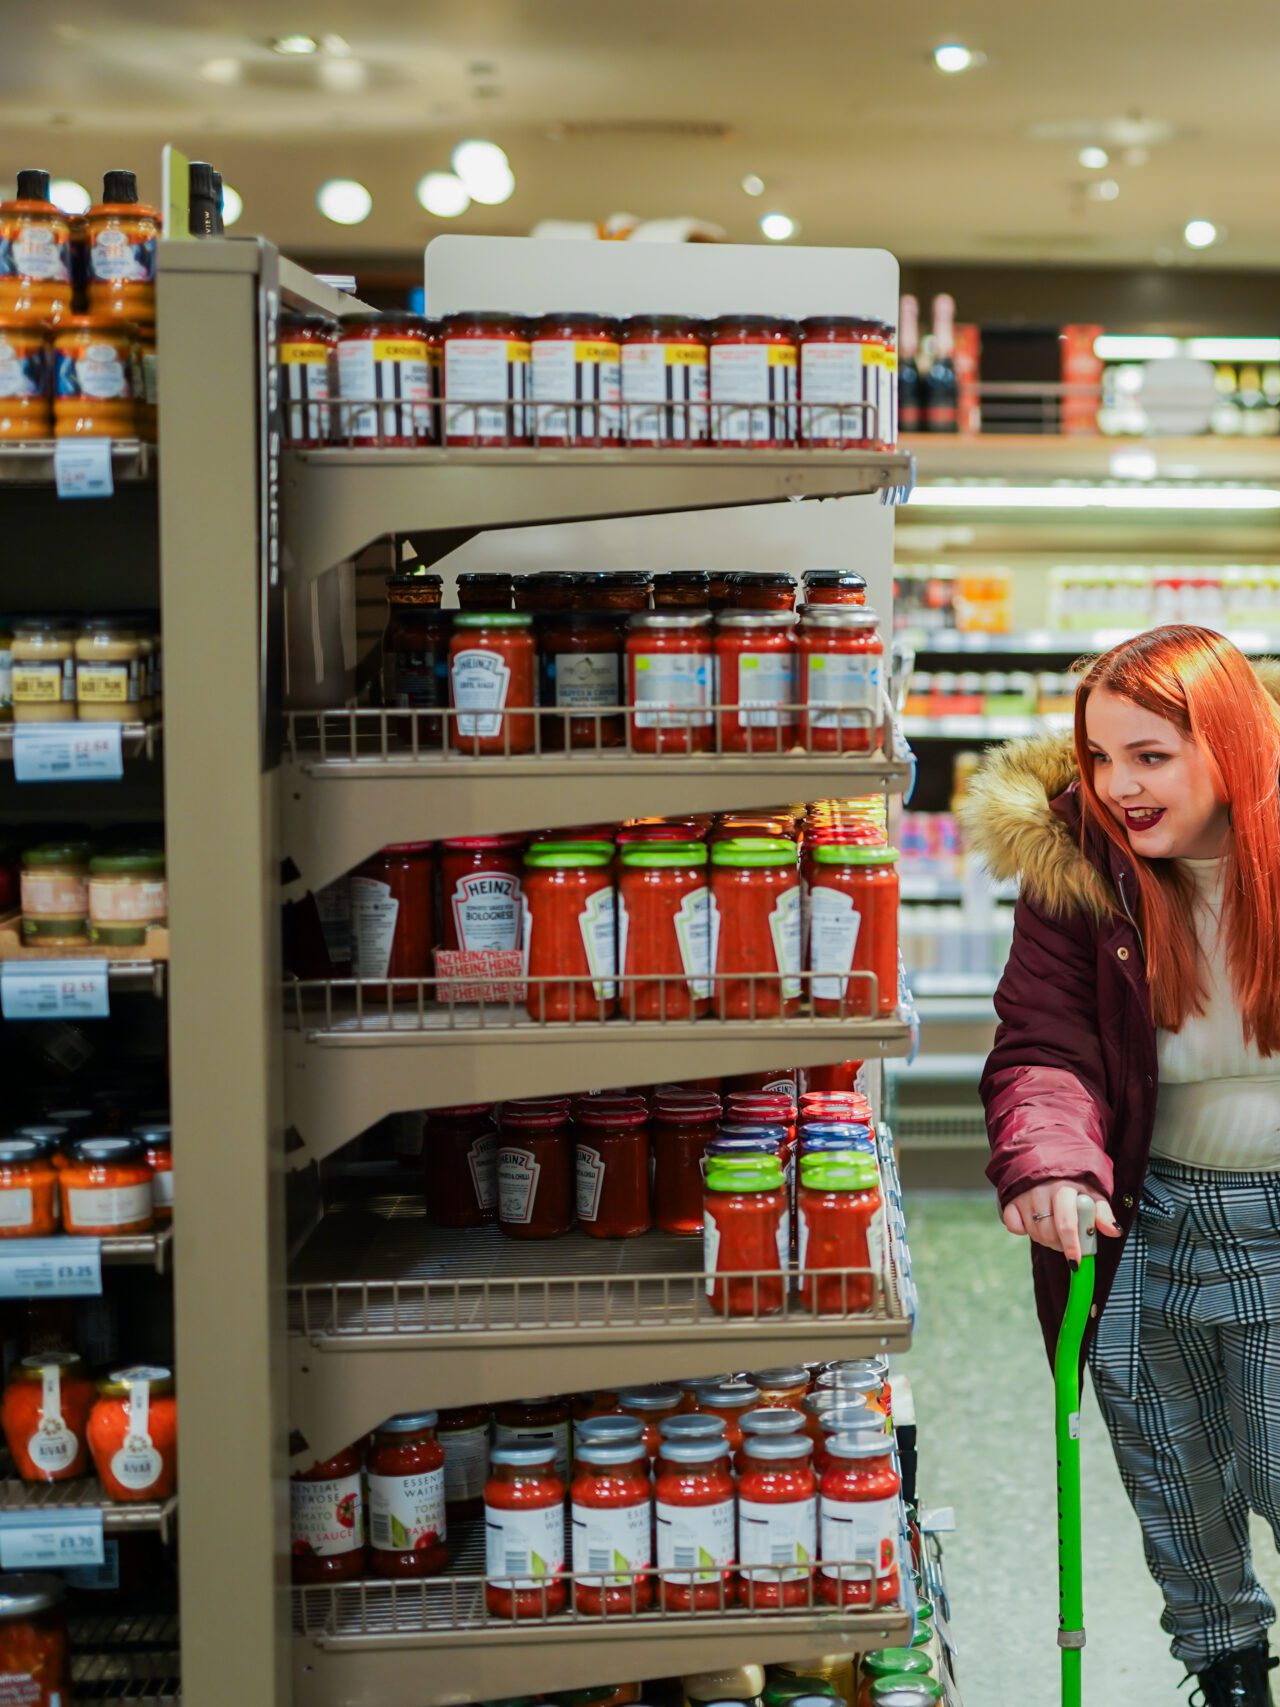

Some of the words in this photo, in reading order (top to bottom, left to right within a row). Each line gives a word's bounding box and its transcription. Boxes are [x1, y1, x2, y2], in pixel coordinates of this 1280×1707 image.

[468, 881, 512, 895] HEINZ
[466, 911, 514, 920] BOLOGNESE
[455, 960, 487, 974] HEINZ
[489, 956, 520, 970] HEINZ
[316, 1530, 353, 1542] SAUCE
